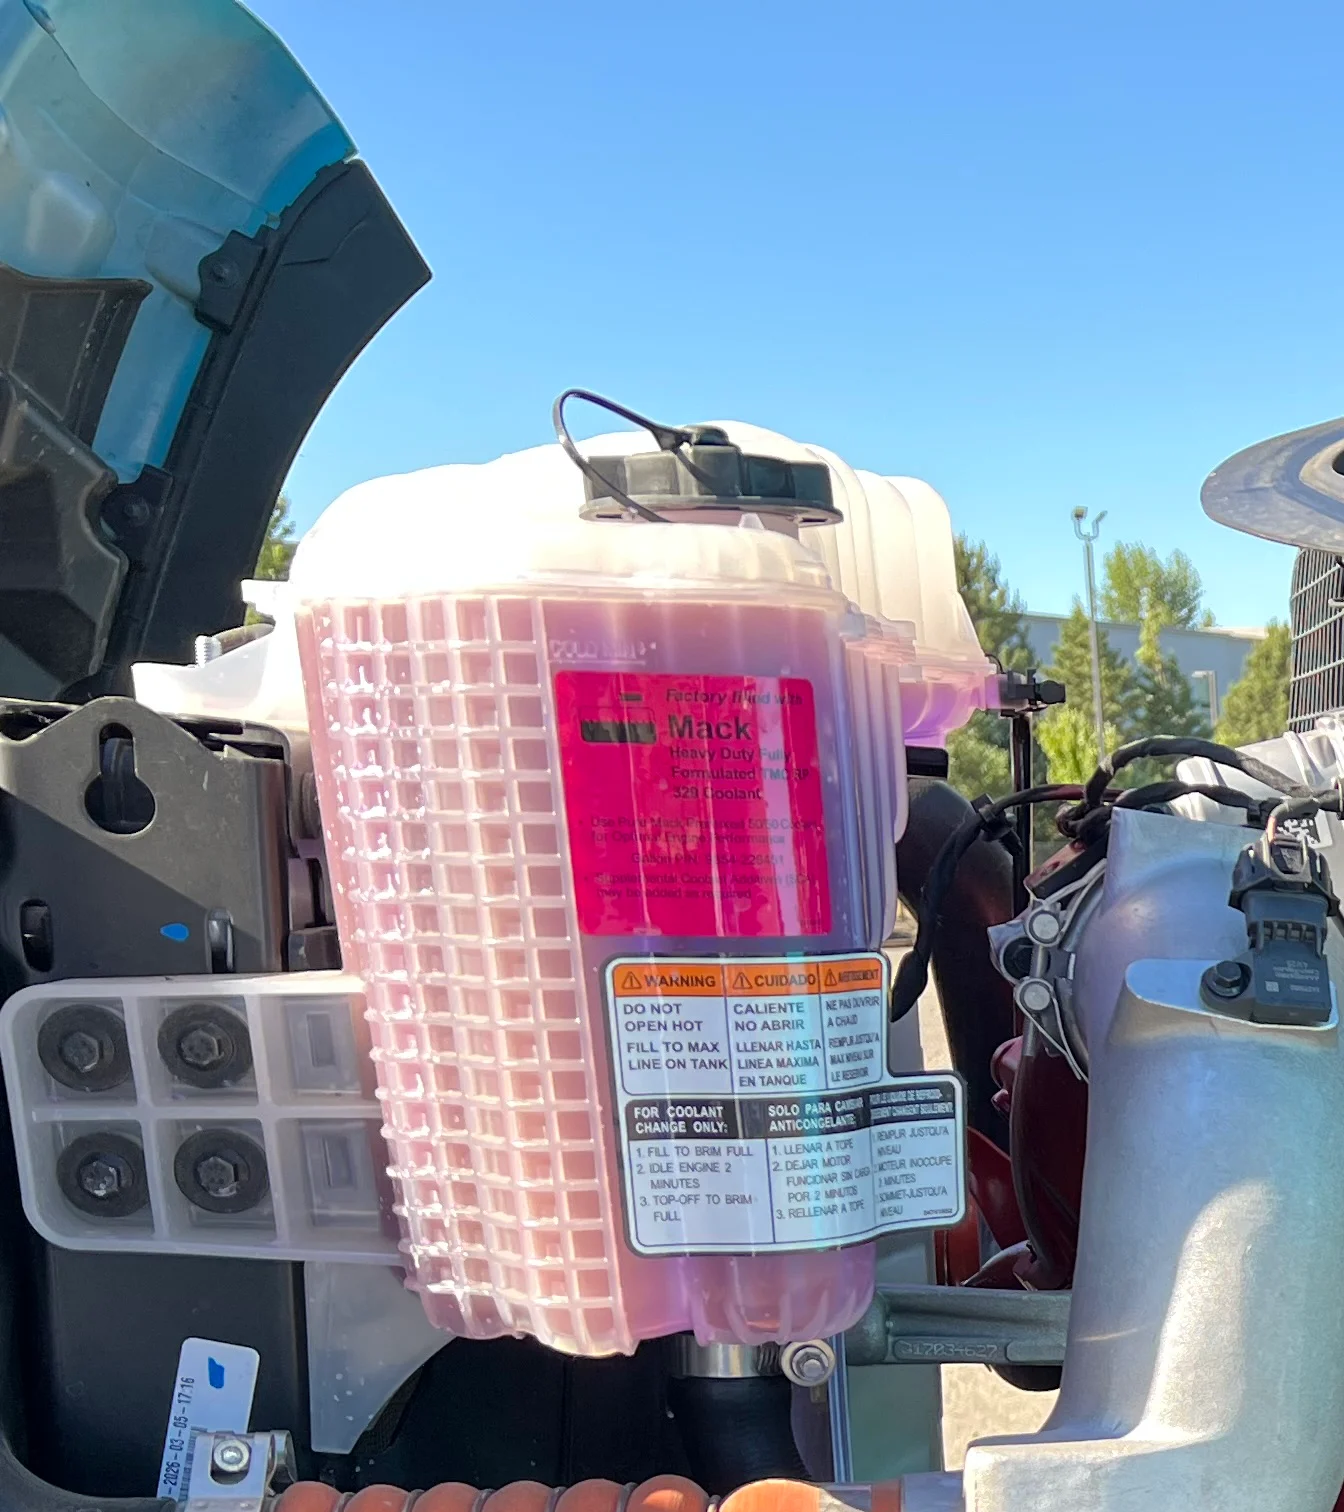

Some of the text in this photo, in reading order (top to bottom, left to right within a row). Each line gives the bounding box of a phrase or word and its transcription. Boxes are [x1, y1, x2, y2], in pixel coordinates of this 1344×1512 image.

[666, 689, 730, 706] Factory
[668, 714, 752, 741] Mack
[670, 748, 715, 760] Heavy
[720, 749, 753, 761] Duty
[672, 767, 755, 780] Formulated
[645, 975, 716, 987] WARNING
[754, 974, 816, 987] CUIDADO
[623, 1002, 682, 1015] DO NOT
[734, 1002, 804, 1014] CALIENTE
[625, 1020, 703, 1032] OPEN HOT
[735, 1018, 805, 1032] NO ABRIR
[628, 1041, 720, 1053] FILL TO MAX
[736, 1039, 821, 1052] LLENAR HASTA
[628, 1058, 728, 1070] LINE ON TANK
[737, 1056, 819, 1070] LINEA MAXIMA
[739, 1074, 806, 1088] EN TANQUE
[634, 1106, 723, 1119] FOR COOLANT
[768, 1102, 831, 1117] SOLO PARA
[635, 1120, 728, 1134] CHANGE ONLY:
[636, 1146, 753, 1158] 1. FILL TO BRIM FULL
[772, 1145, 781, 1156] 1.
[784, 1142, 823, 1154] LLENAR
[826, 1141, 832, 1151] A
[649, 1162, 674, 1173] IDLE
[679, 1162, 720, 1173] ENGINE
[725, 1162, 731, 1173] 2
[786, 1158, 818, 1171] DEJAR
[650, 1178, 700, 1189] MINUTES
[653, 1194, 700, 1205] TOP-OFF
[707, 1194, 722, 1205] TO
[726, 1194, 752, 1205] BRIM
[788, 1190, 811, 1203] POR
[814, 1190, 821, 1201] 2
[654, 1210, 681, 1222] FULL
[788, 1204, 839, 1218] RELLENAR
